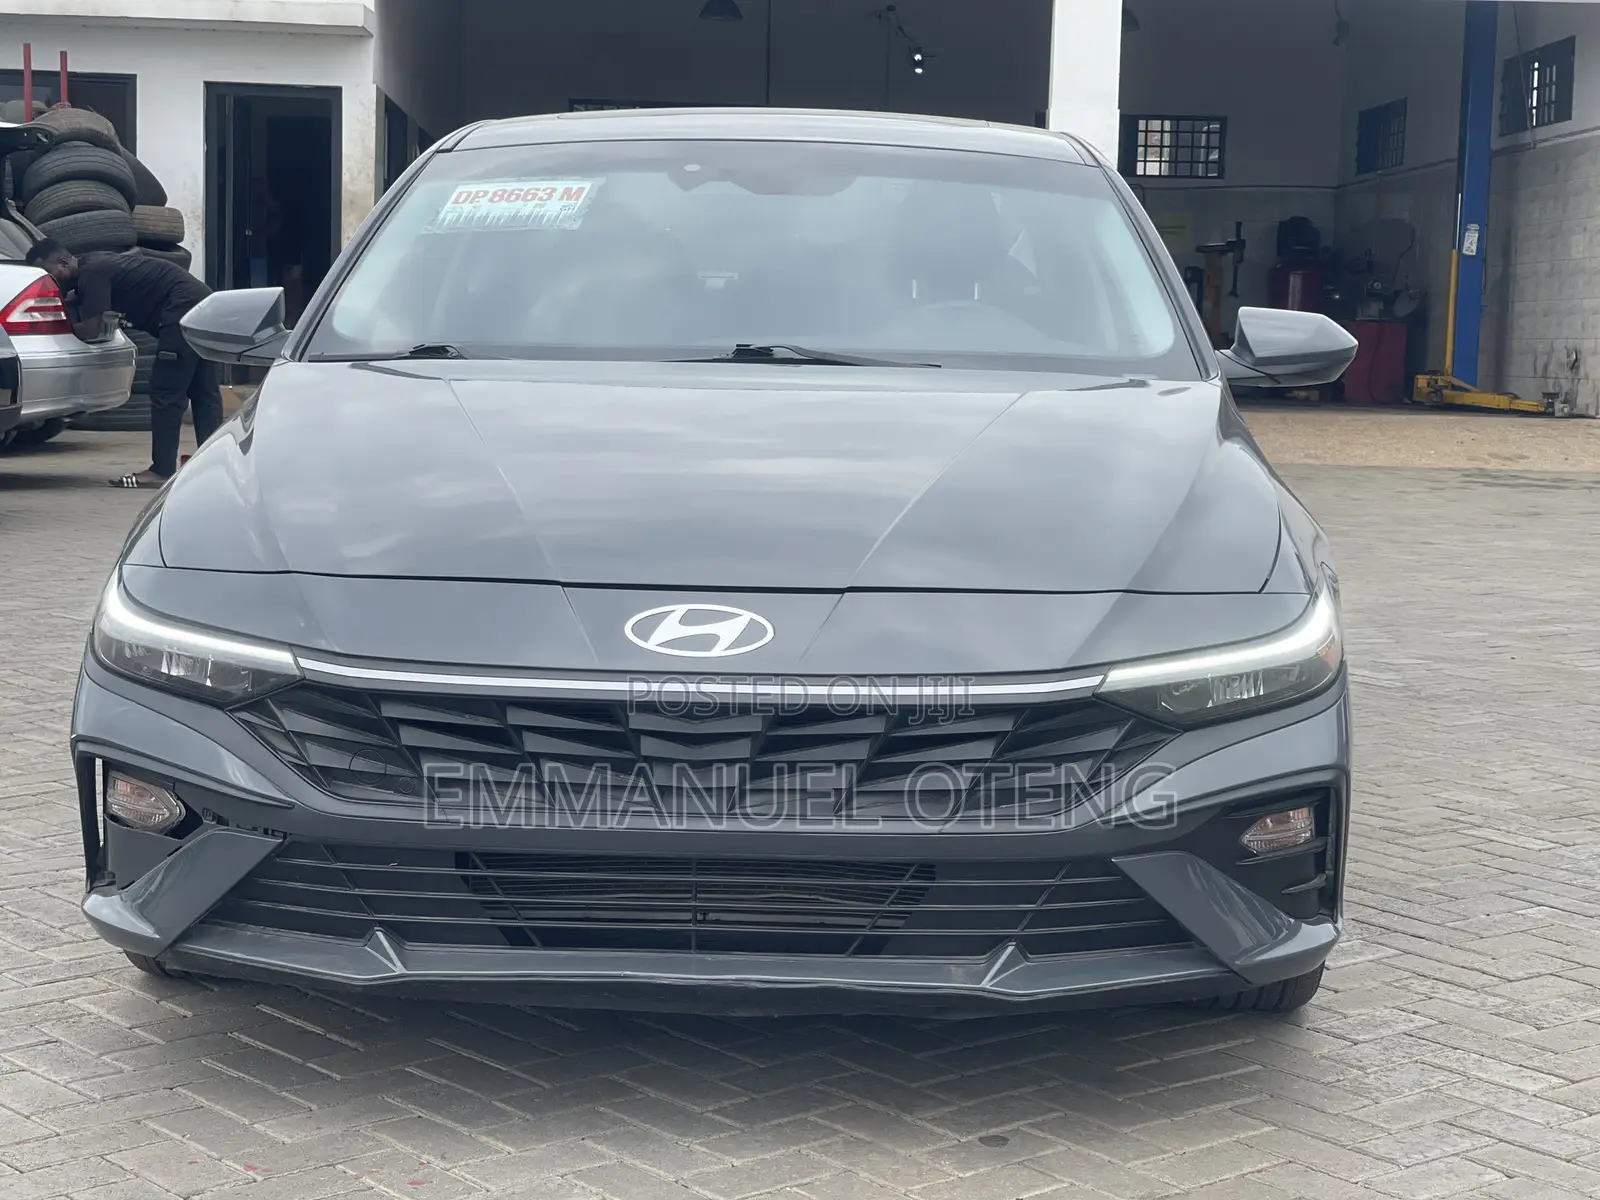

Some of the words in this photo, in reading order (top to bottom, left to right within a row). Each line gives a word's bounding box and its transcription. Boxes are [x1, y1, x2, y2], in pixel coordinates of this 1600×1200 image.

[452, 190, 489, 204] DP
[488, 187, 557, 203] 8663
[558, 187, 586, 201] M
